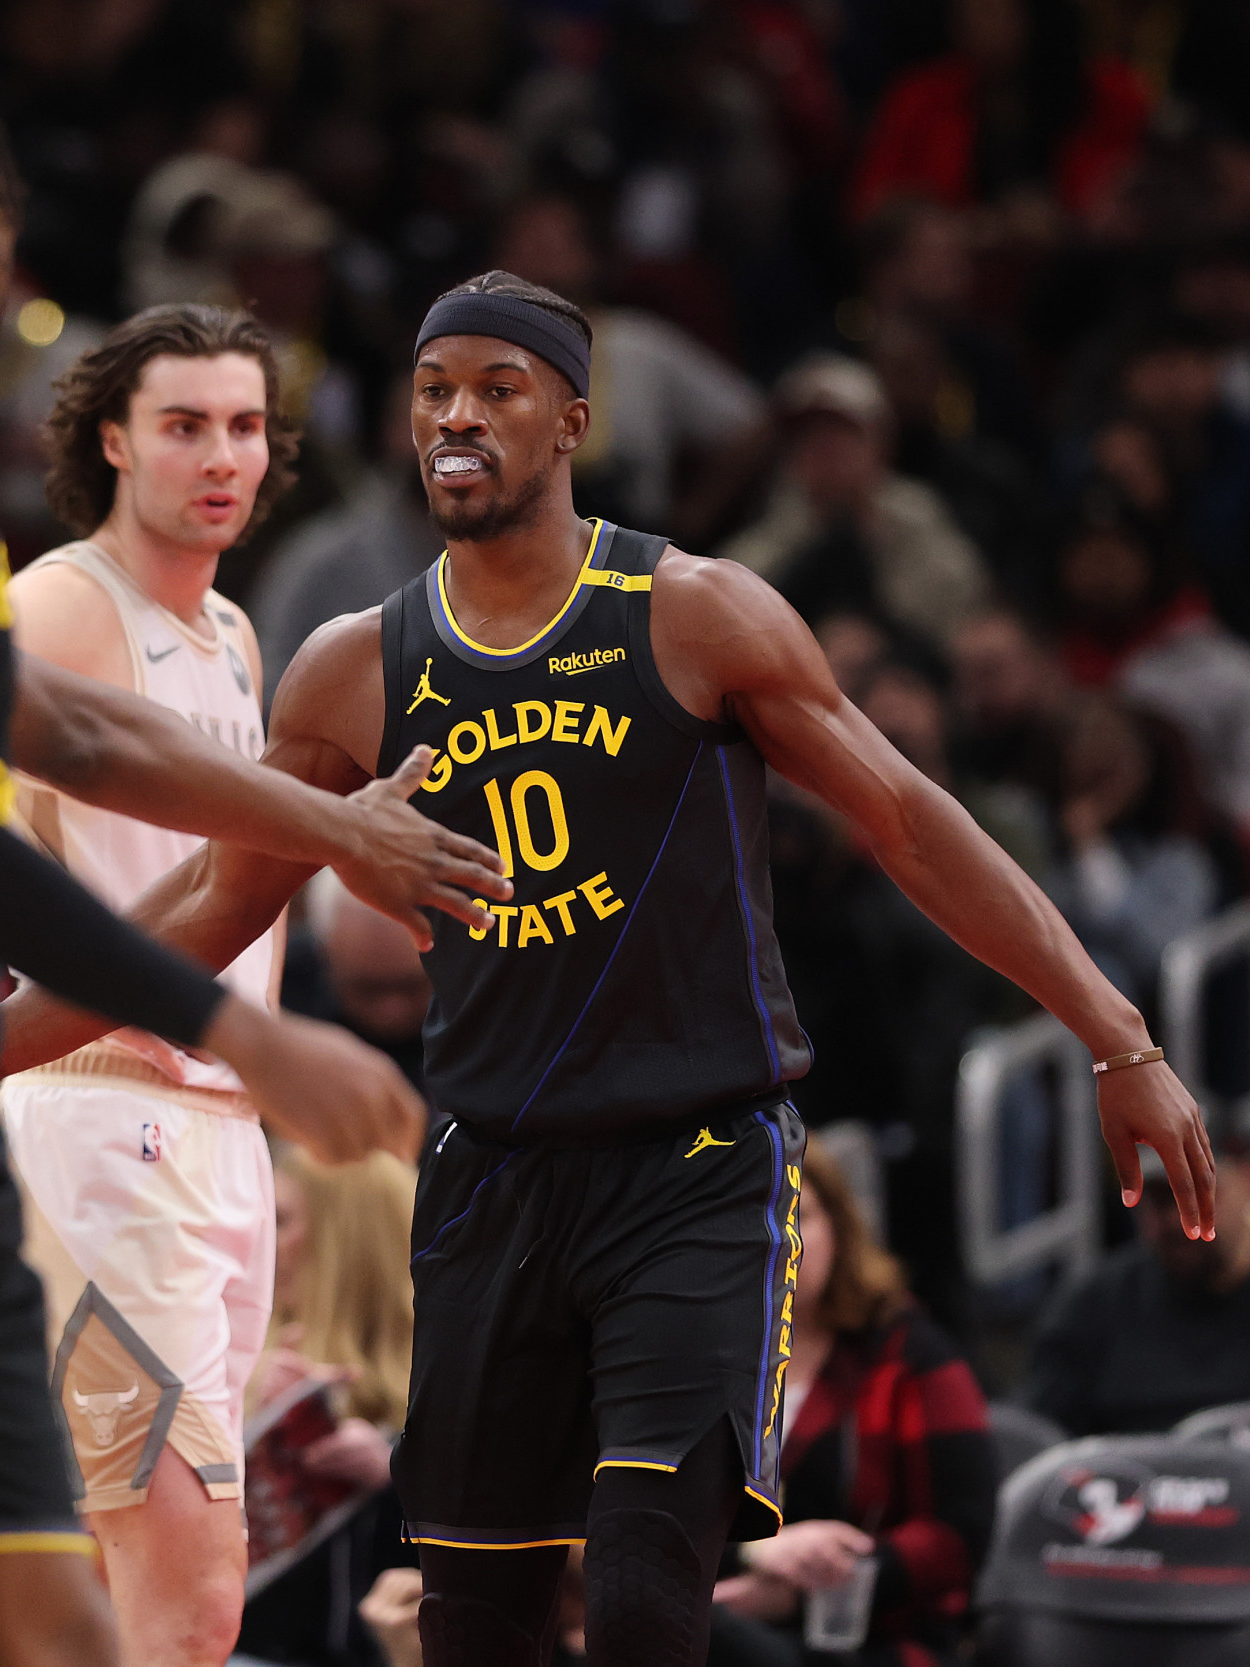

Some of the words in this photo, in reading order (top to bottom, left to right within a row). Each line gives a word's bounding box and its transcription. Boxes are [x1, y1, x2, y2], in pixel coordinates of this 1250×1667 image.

[606, 573, 625, 586] 16
[548, 647, 626, 675] Rakuten
[420, 700, 632, 793] GOLDEN
[483, 769, 570, 879] 10
[468, 871, 625, 948] STATE
